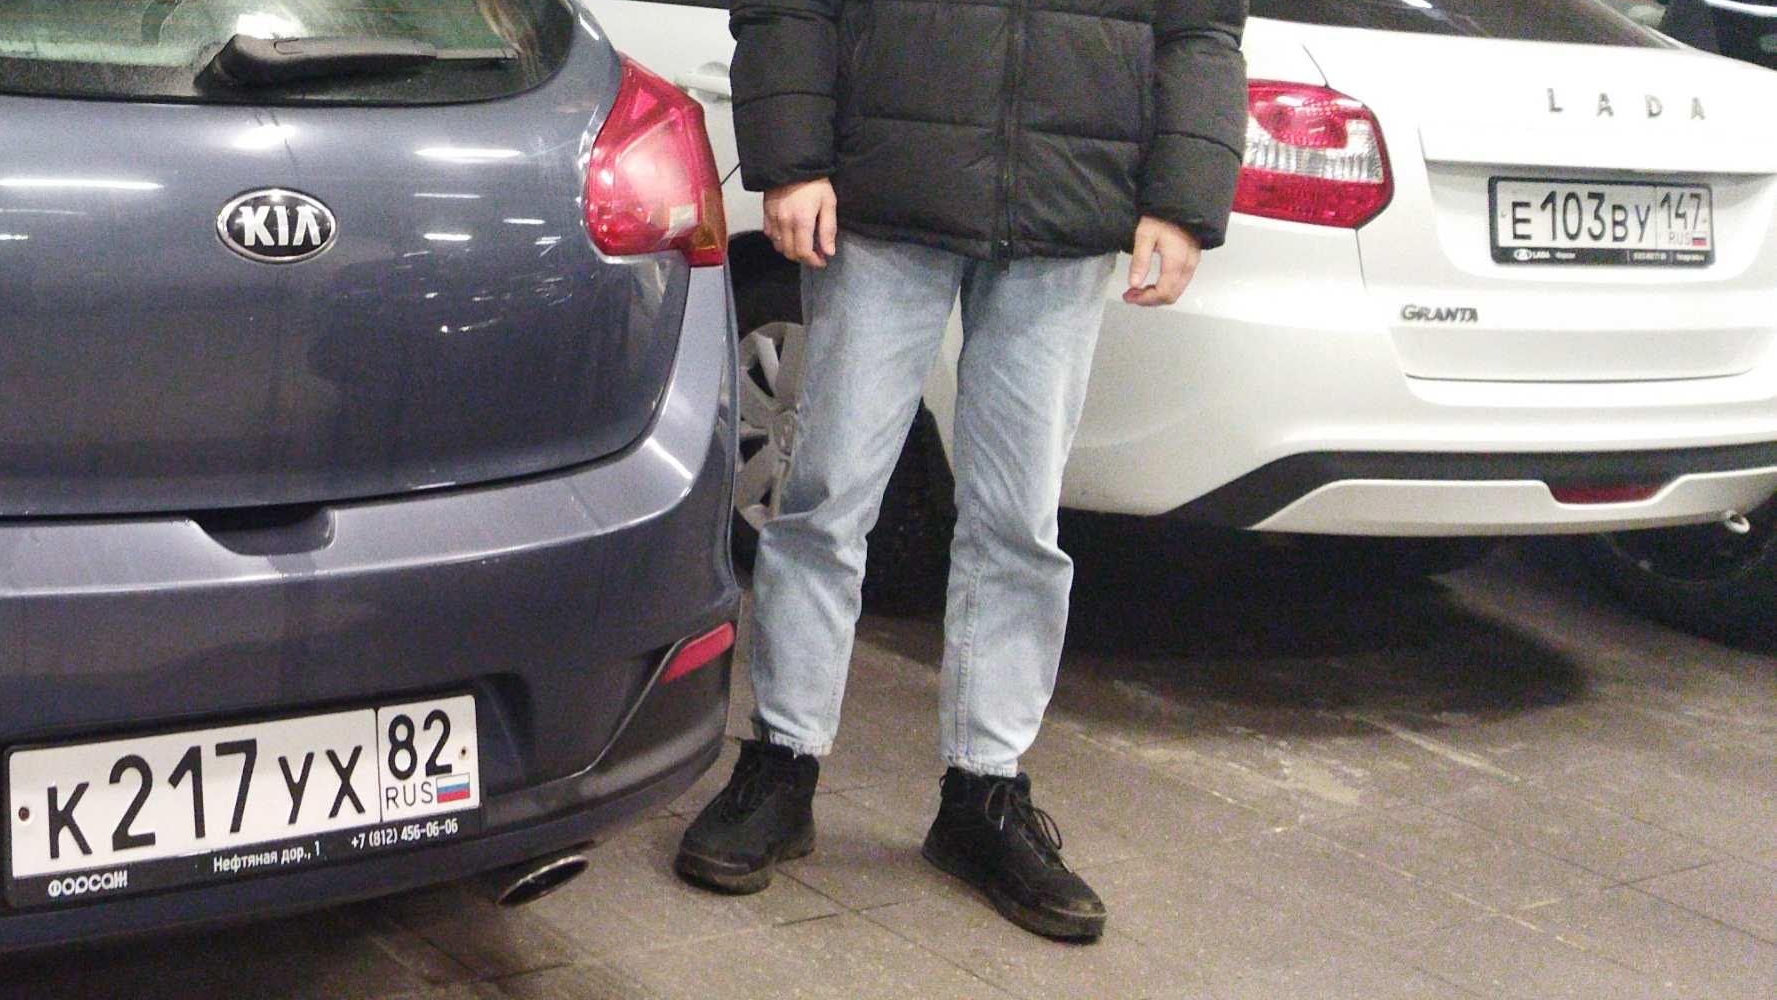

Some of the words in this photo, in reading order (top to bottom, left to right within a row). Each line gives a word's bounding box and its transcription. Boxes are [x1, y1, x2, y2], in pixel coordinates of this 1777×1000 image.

[1547, 88, 1706, 120] LADA
[241, 204, 323, 247] KIA
[1660, 191, 1702, 231] 147
[1669, 231, 1691, 246] RUS
[1401, 304, 1478, 322] GRANTA
[47, 739, 366, 859] К217УХ
[388, 709, 453, 780] 82
[385, 780, 433, 809] RUS
[351, 833, 365, 849] +7
[368, 828, 397, 847] (812)
[401, 817, 459, 841] 456-06-06
[213, 850, 278, 874] Нефтяная
[314, 841, 320, 856] 1
